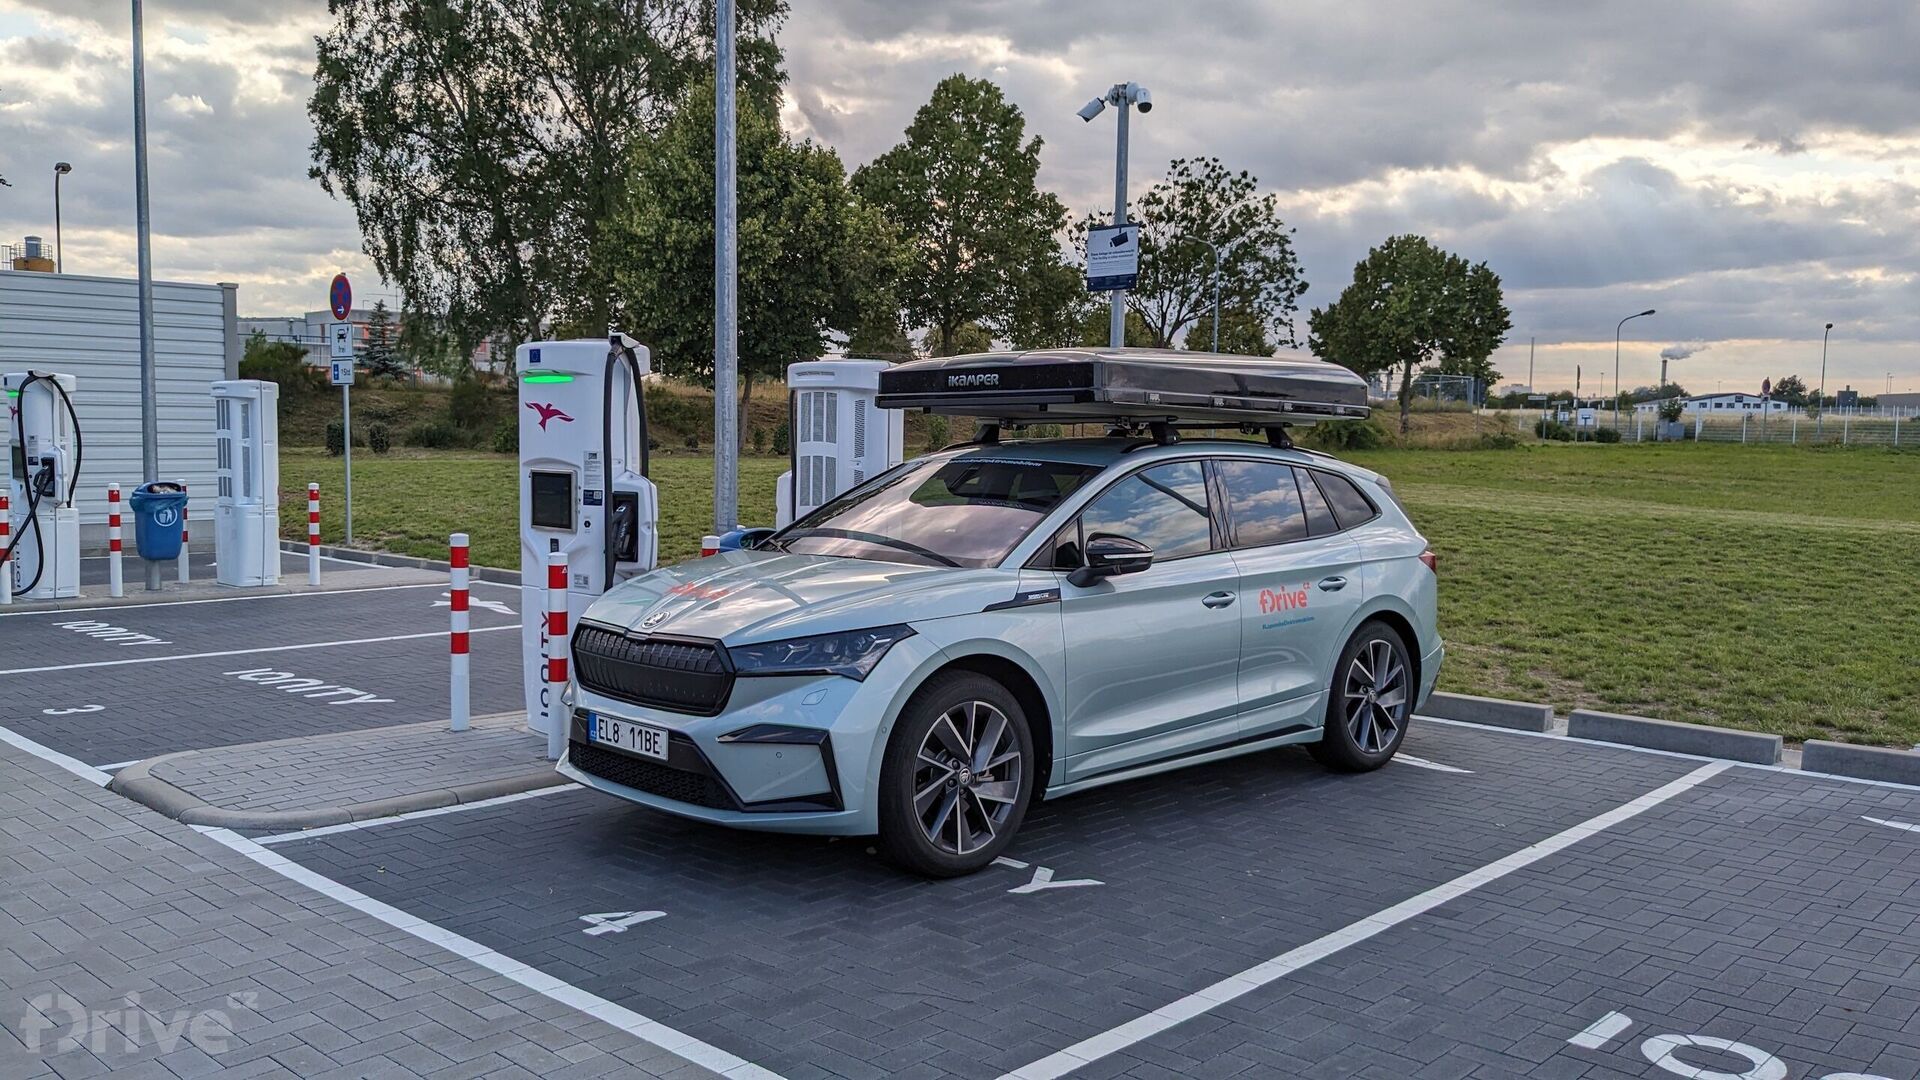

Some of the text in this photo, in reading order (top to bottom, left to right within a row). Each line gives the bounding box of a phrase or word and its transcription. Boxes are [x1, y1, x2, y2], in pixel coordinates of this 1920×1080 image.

[53, 620, 173, 646] IONITY
[223, 668, 395, 705] IONITY
[43, 704, 105, 715] 3
[598, 719, 620, 743] EL8
[630, 727, 660, 755] 11BE
[579, 911, 668, 935] 4
